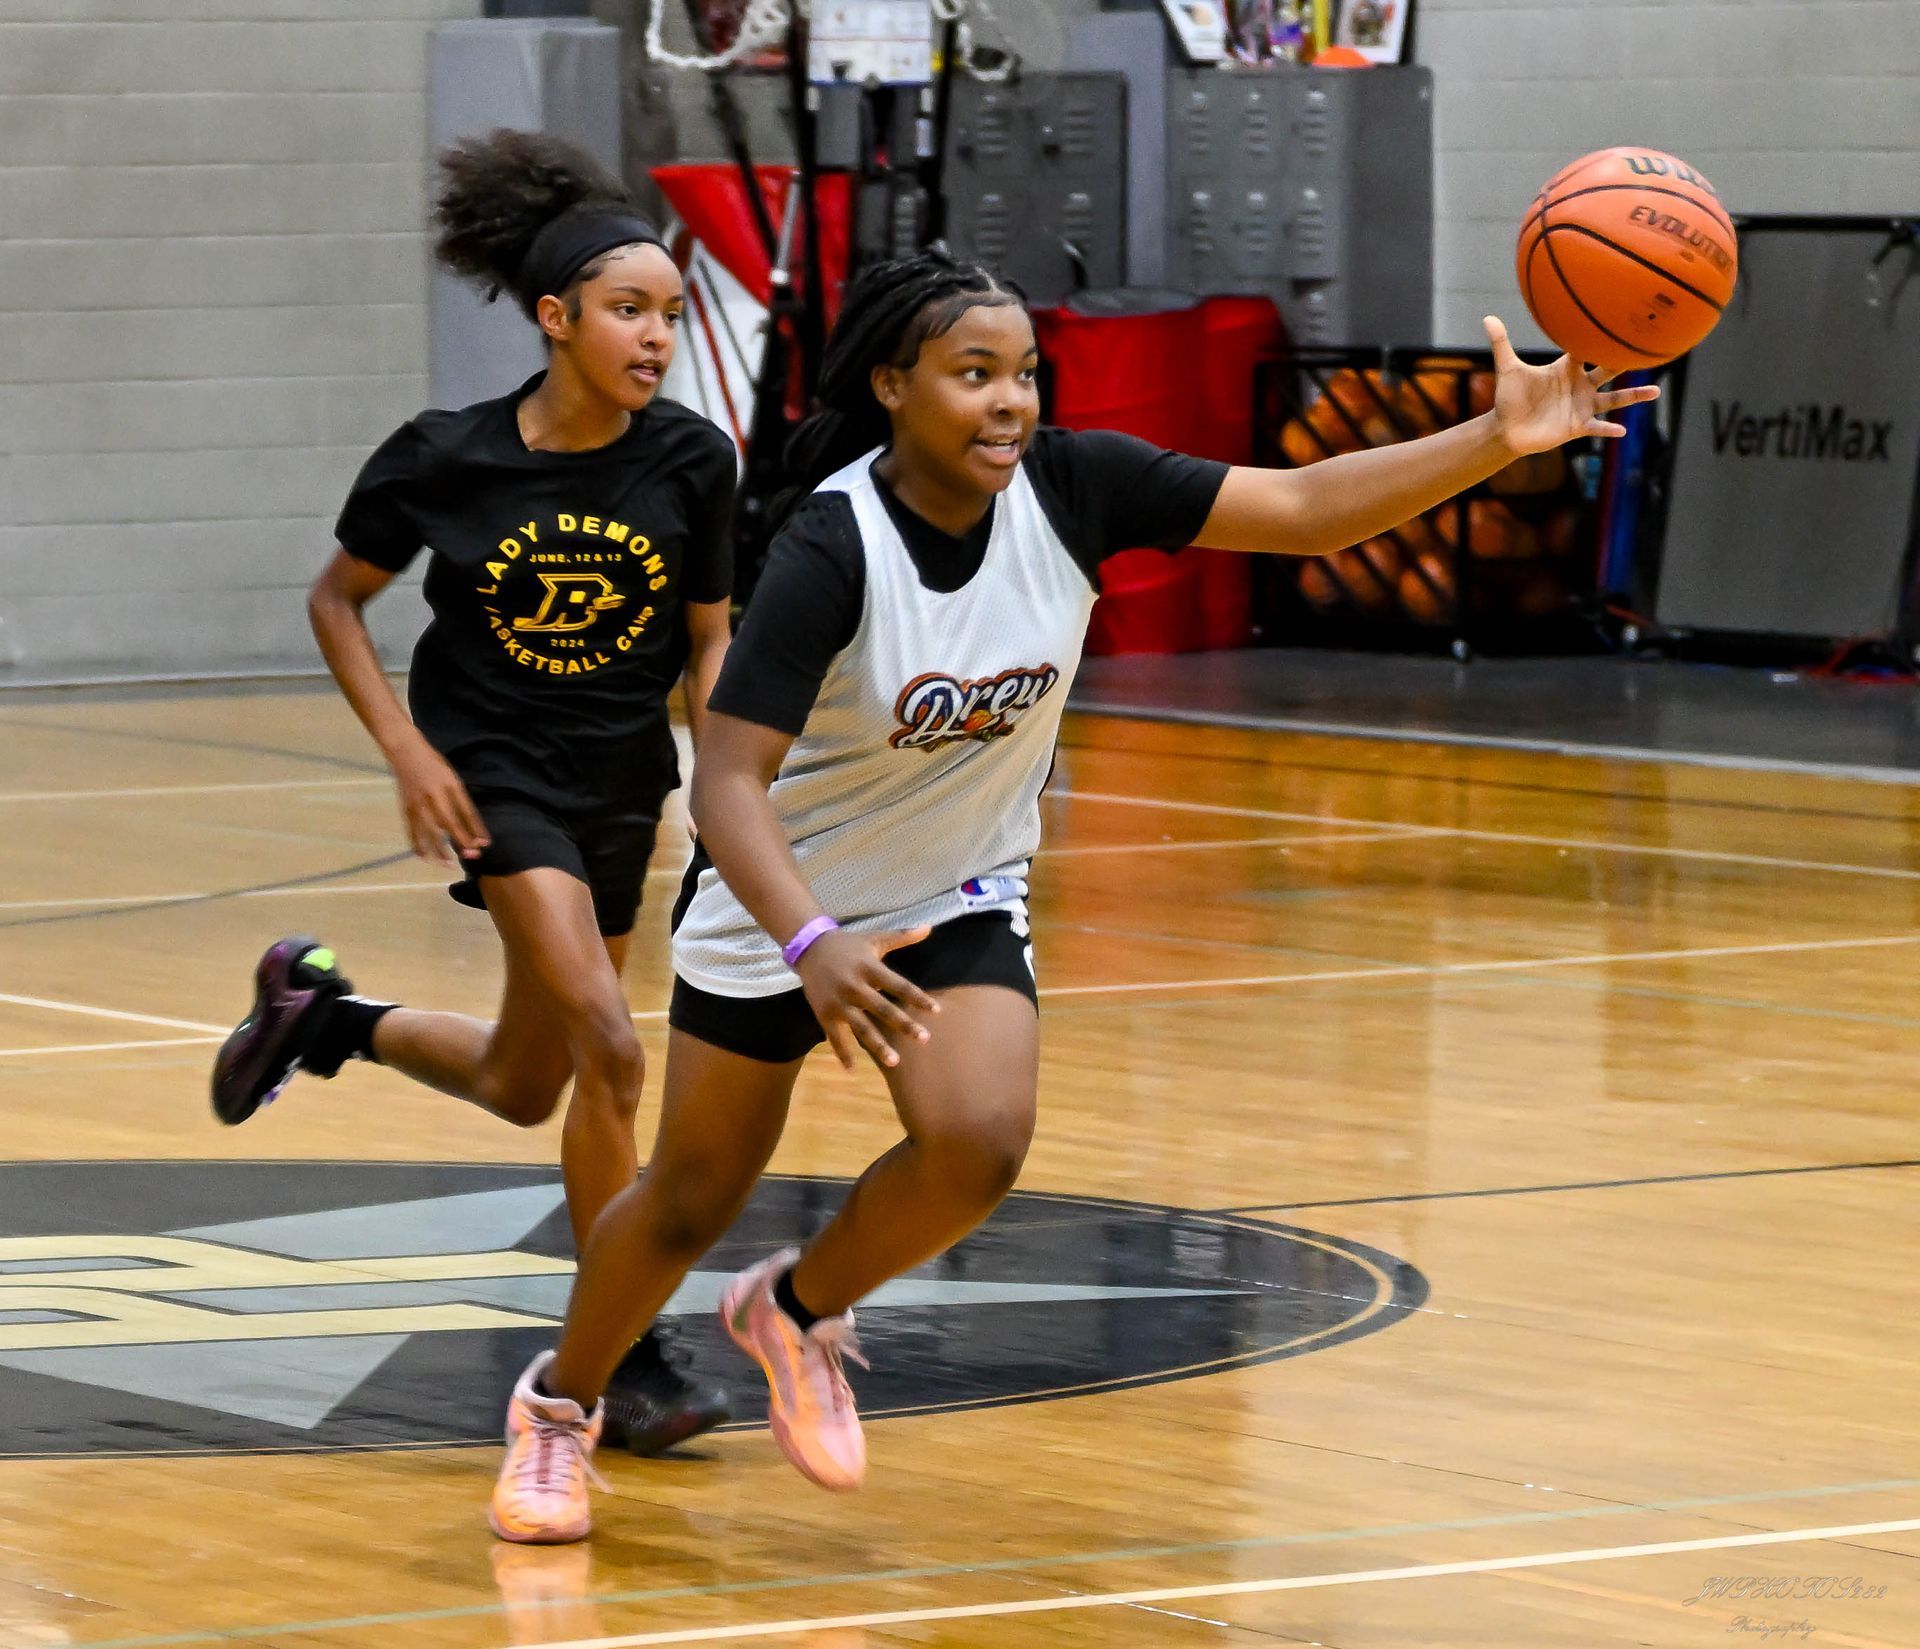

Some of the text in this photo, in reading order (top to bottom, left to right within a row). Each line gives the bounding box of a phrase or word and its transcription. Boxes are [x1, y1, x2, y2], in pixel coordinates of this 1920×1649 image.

[1710, 400, 1893, 461] VertiMax
[475, 513, 668, 596] LADY DEMONS
[483, 605, 611, 675] ASKETBALL
[550, 638, 586, 648] 2024
[888, 662, 1059, 750] Drew
